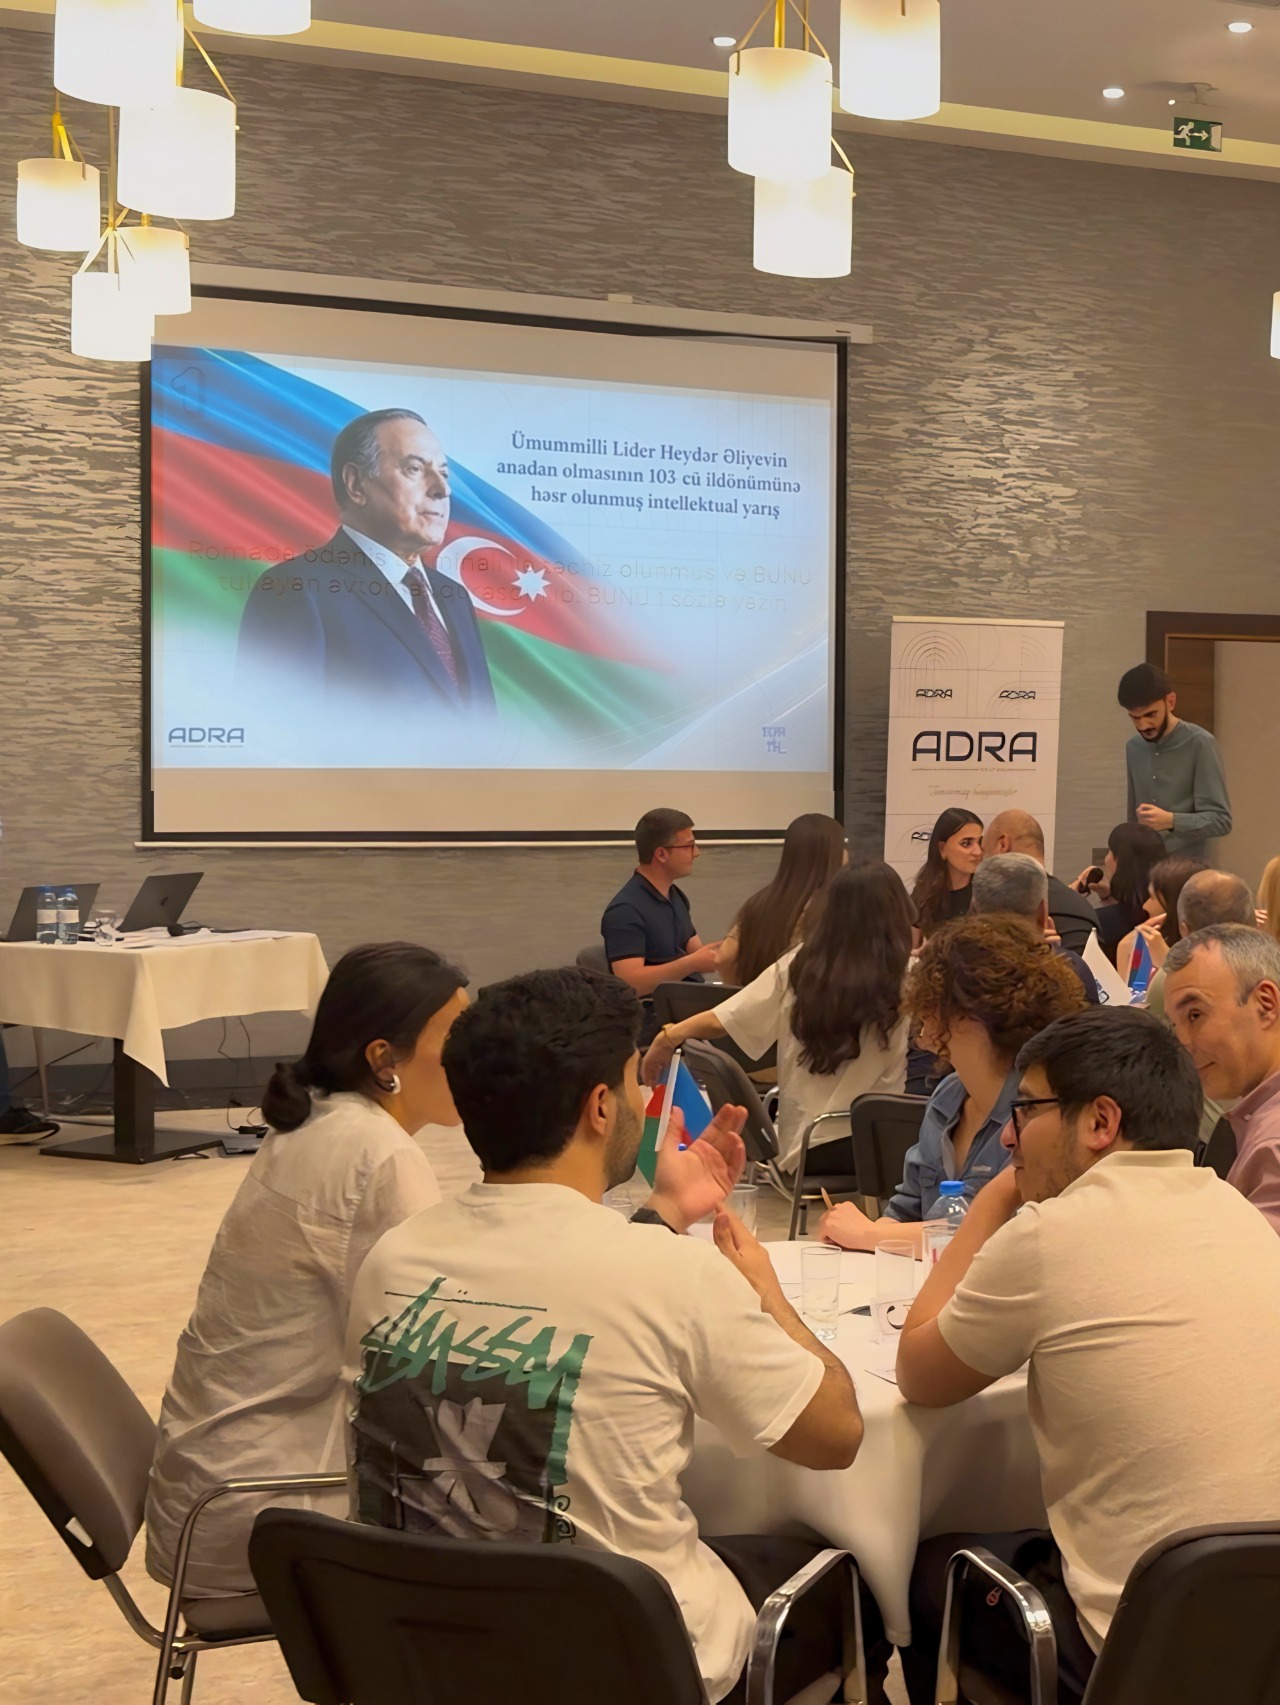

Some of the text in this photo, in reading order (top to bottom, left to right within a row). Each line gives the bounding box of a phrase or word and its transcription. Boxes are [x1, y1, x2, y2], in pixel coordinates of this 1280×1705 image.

[511, 430, 788, 471] Ümummilli Lider Heydər Əliyevin
[496, 460, 801, 493] anadan olmasının 103 cü ildönümünə
[531, 486, 780, 519] həsr olunmuş intellektual yarış
[754, 564, 812, 585] BUNU
[168, 727, 244, 743] ADRA
[912, 731, 1037, 762] ADRA
